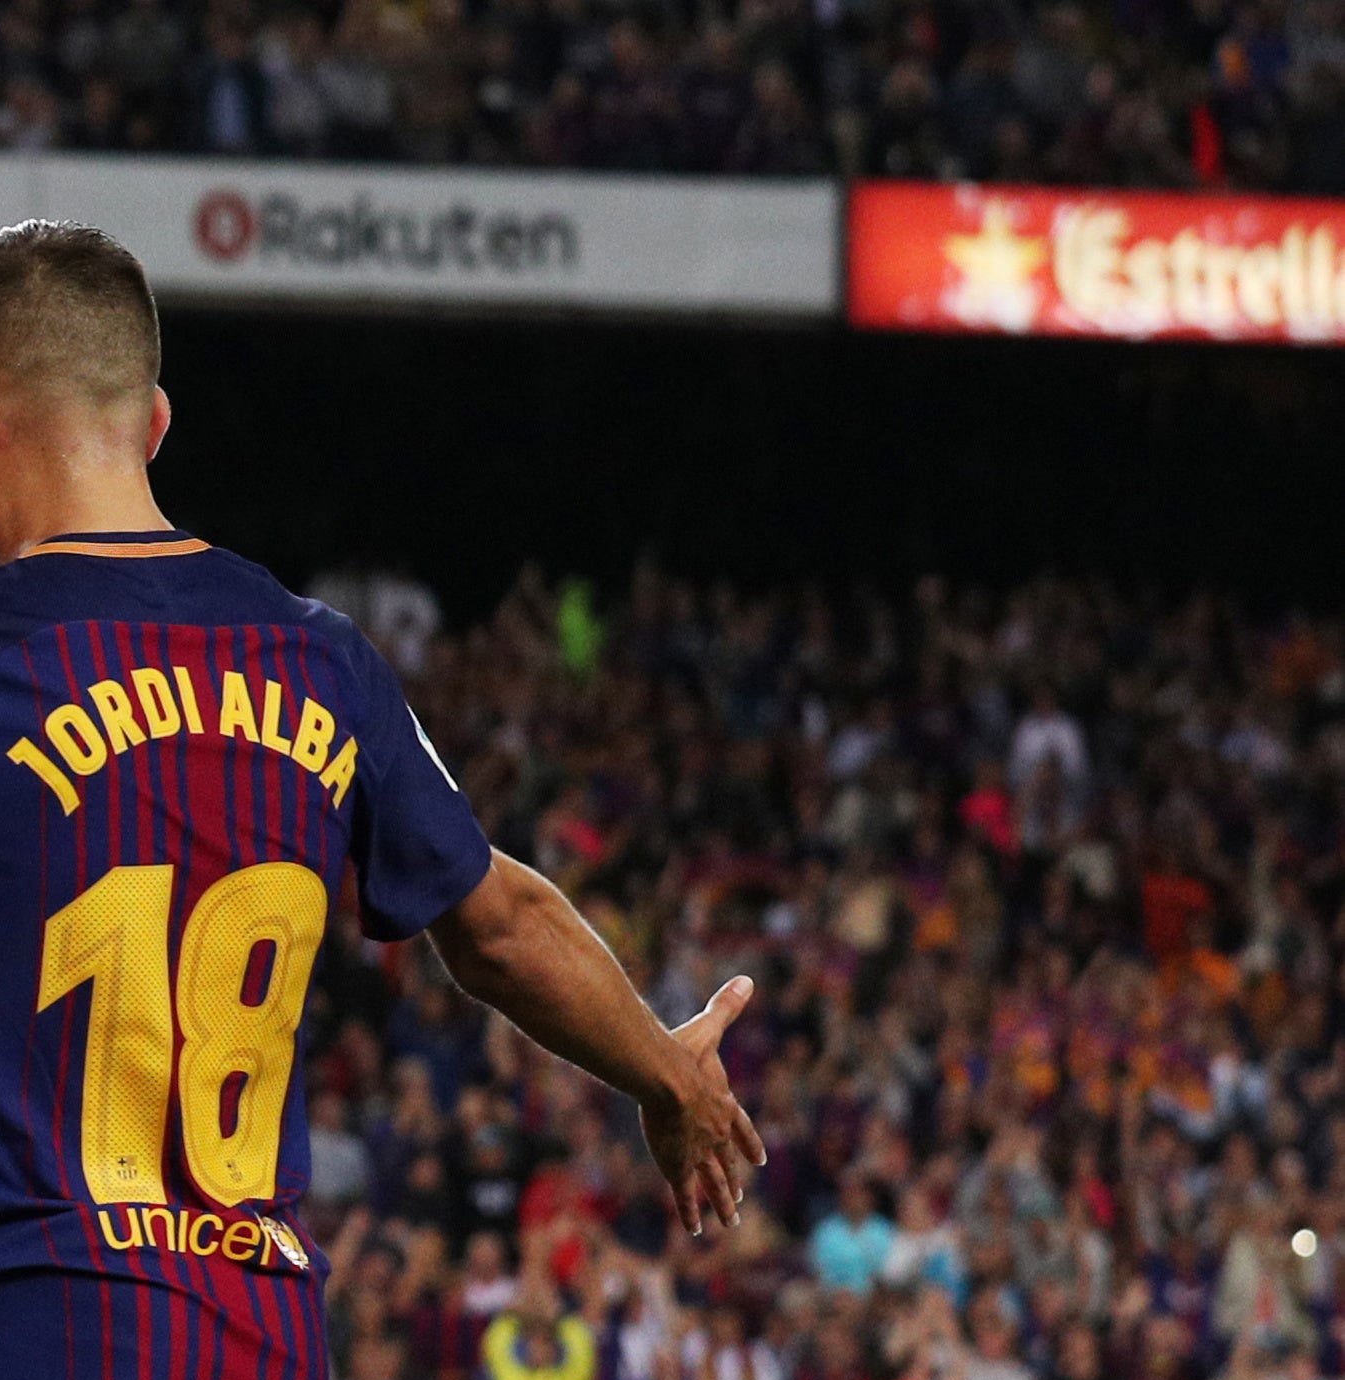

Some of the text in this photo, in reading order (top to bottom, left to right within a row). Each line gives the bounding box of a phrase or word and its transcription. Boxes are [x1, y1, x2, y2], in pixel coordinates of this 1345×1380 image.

[259, 191, 580, 271] Rakuten
[1051, 202, 1345, 334] Estrell
[5, 666, 359, 817] JORDI ALBA
[37, 862, 328, 1209] 18
